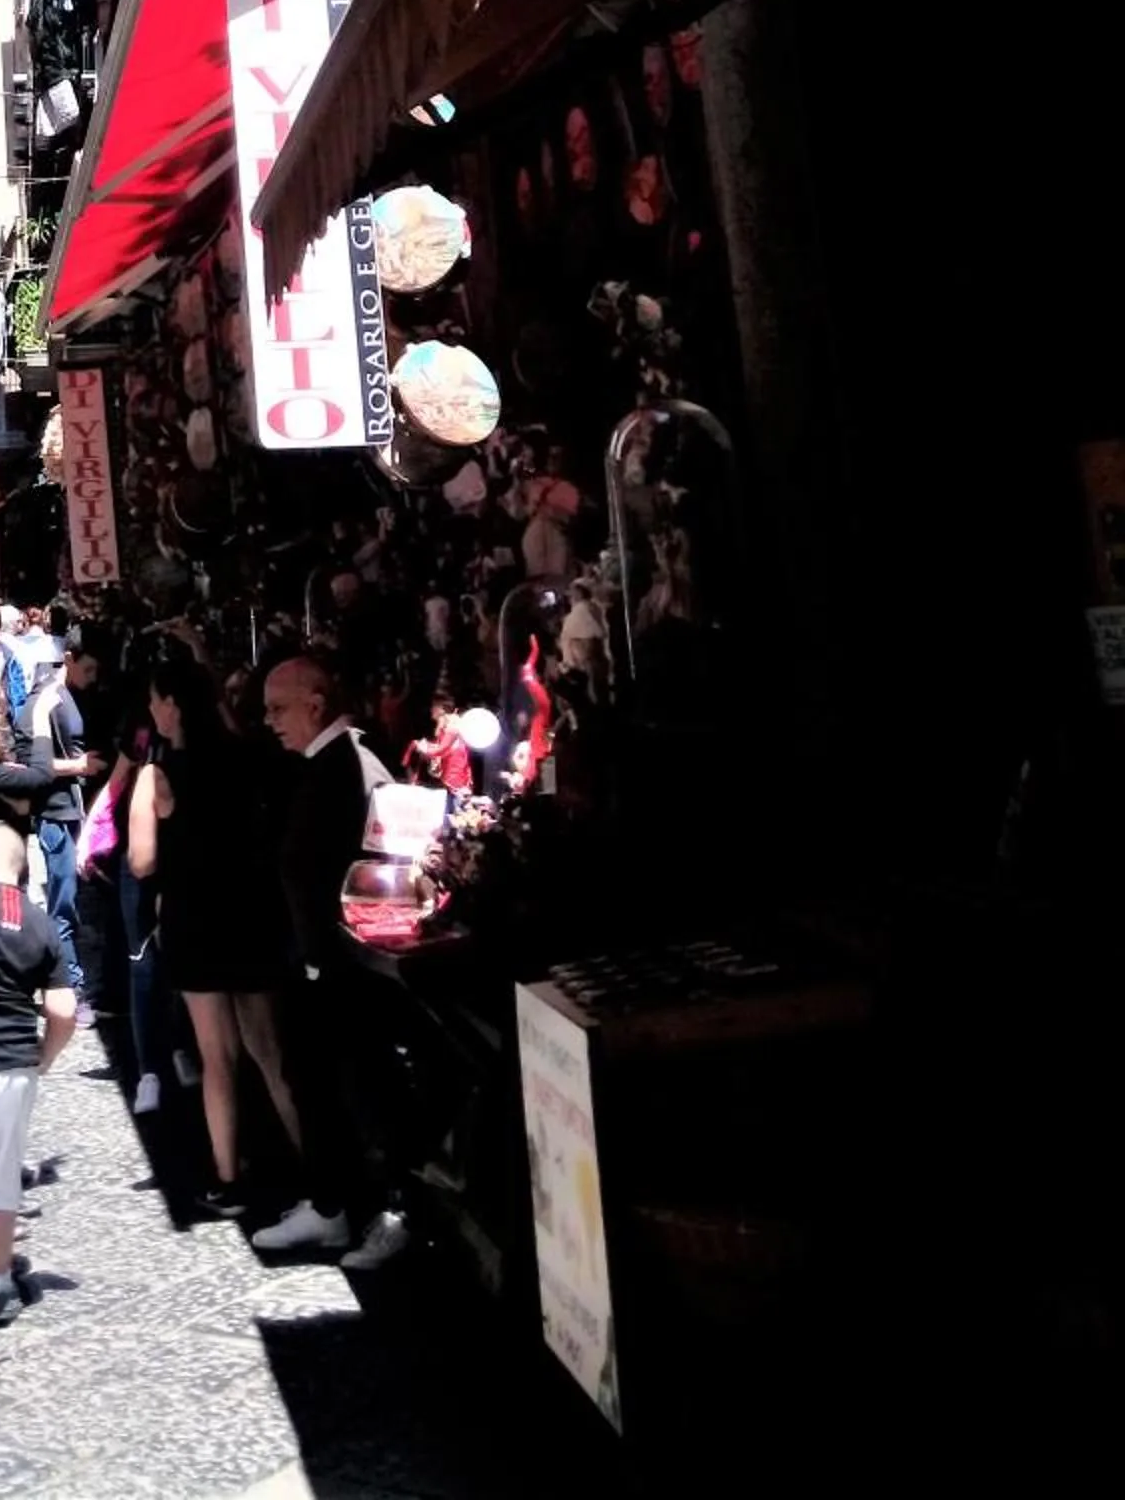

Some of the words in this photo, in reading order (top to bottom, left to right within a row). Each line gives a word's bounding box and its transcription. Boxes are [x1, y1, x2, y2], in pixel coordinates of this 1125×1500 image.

[243, 63, 345, 441] VILIO
[357, 261, 376, 277] E
[64, 371, 97, 409] DI
[359, 289, 391, 437] ROSARIO
[68, 420, 114, 579] VIRGILIO
